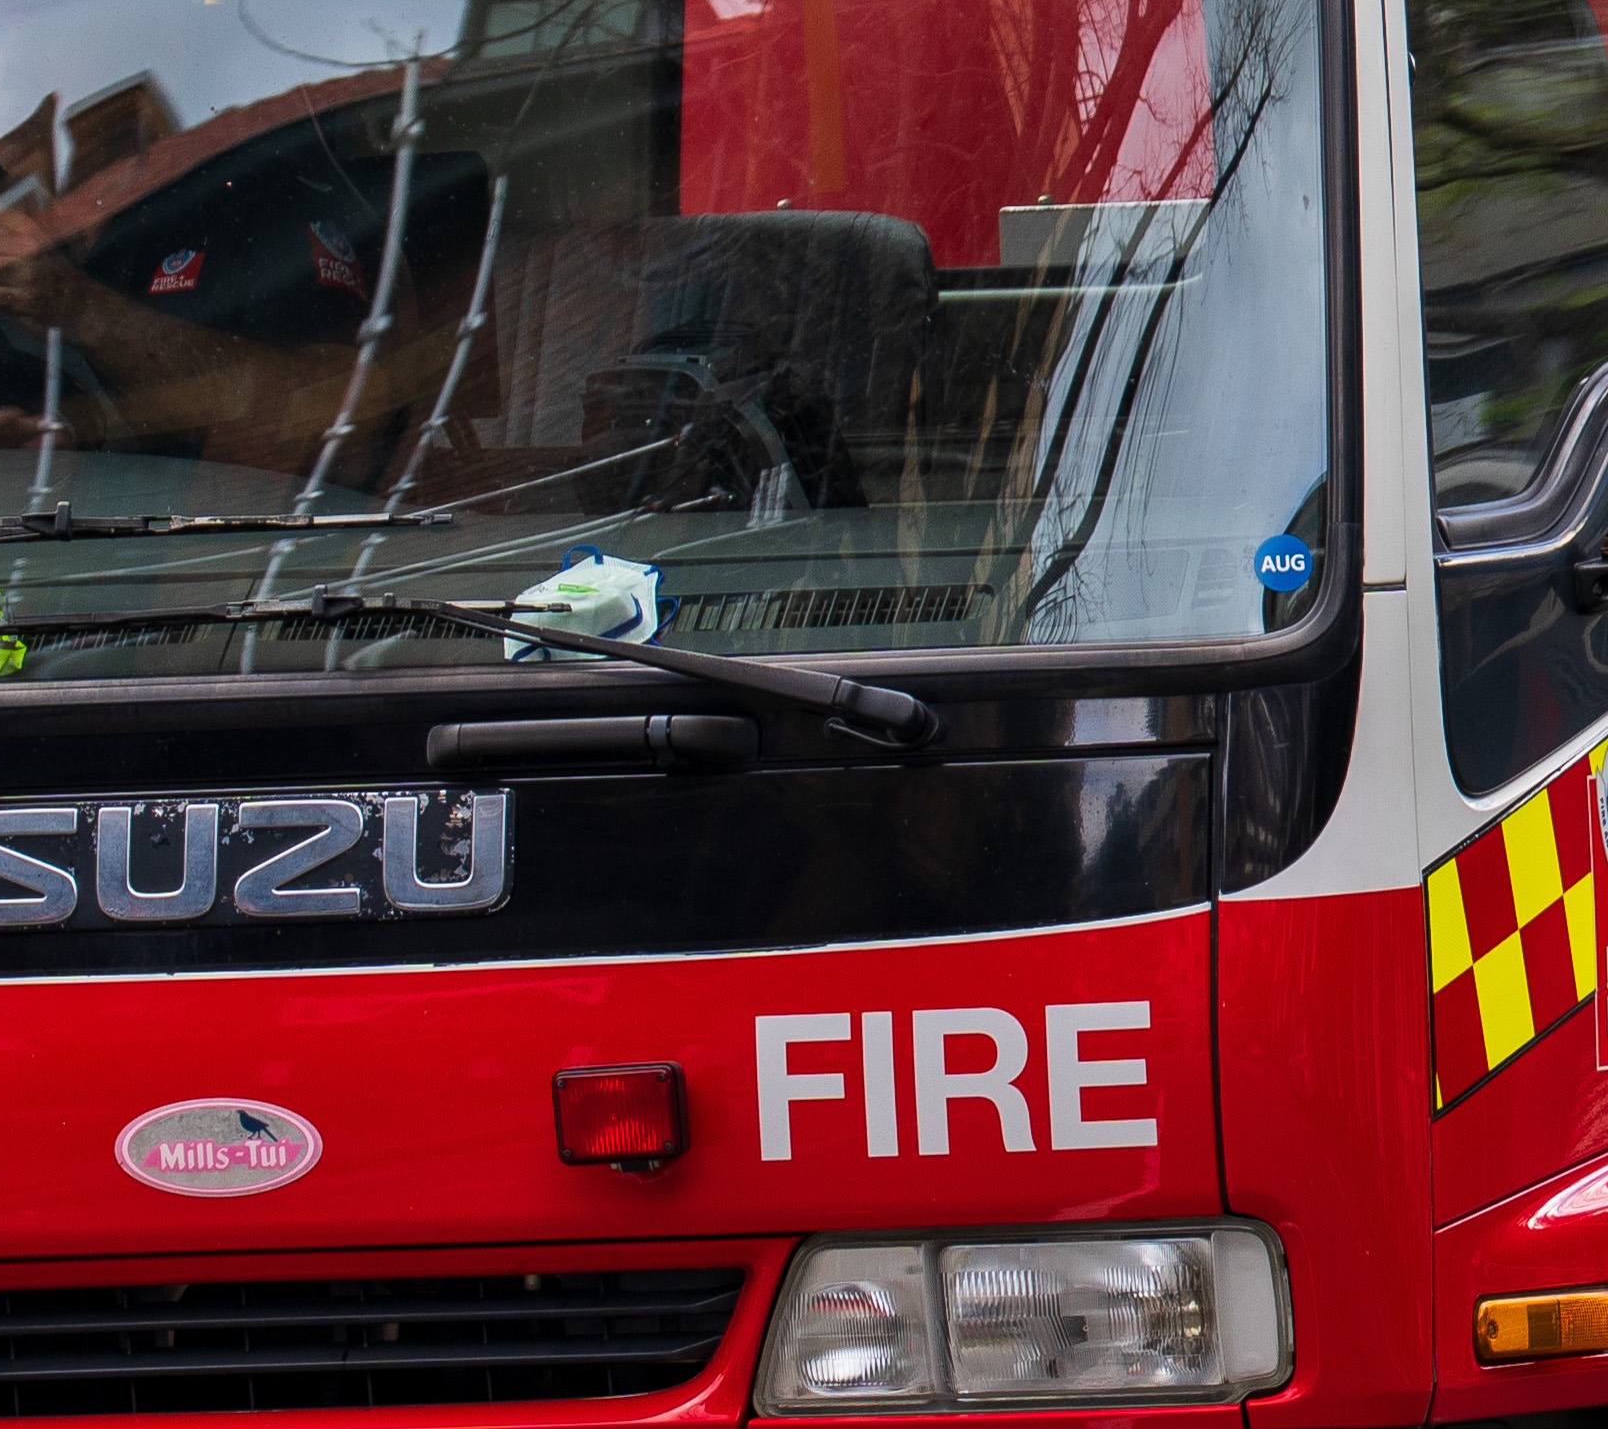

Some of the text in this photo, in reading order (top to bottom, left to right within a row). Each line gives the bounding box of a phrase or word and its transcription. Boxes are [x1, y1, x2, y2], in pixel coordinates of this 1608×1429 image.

[1261, 553, 1305, 573] AUG
[755, 1000, 1158, 1162] FIRE
[159, 1137, 288, 1171] Mills-Tui
